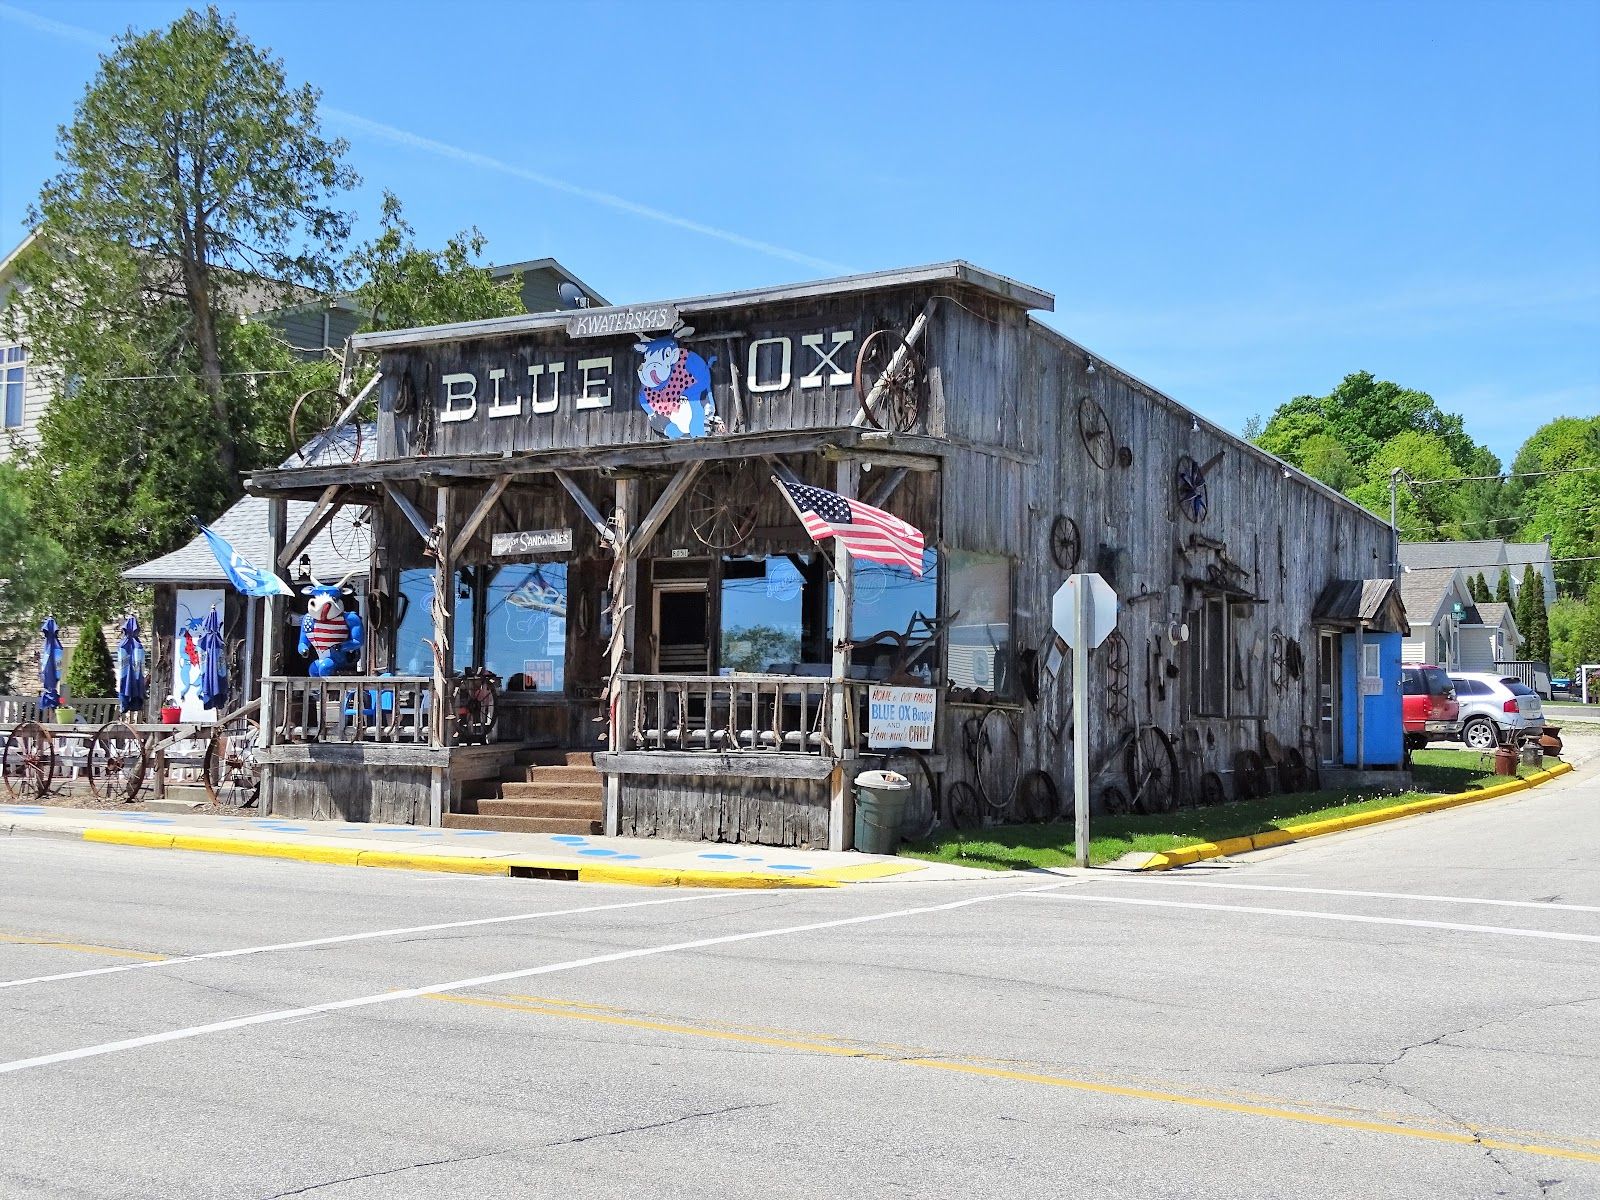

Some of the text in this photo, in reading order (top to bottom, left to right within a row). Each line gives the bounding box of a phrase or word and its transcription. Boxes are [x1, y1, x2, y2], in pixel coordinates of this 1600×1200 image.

[440, 330, 854, 423] BLUE OX
[519, 532, 569, 551] SANDWICHES
[872, 704, 895, 720] BLUE
[898, 704, 911, 721] OX
